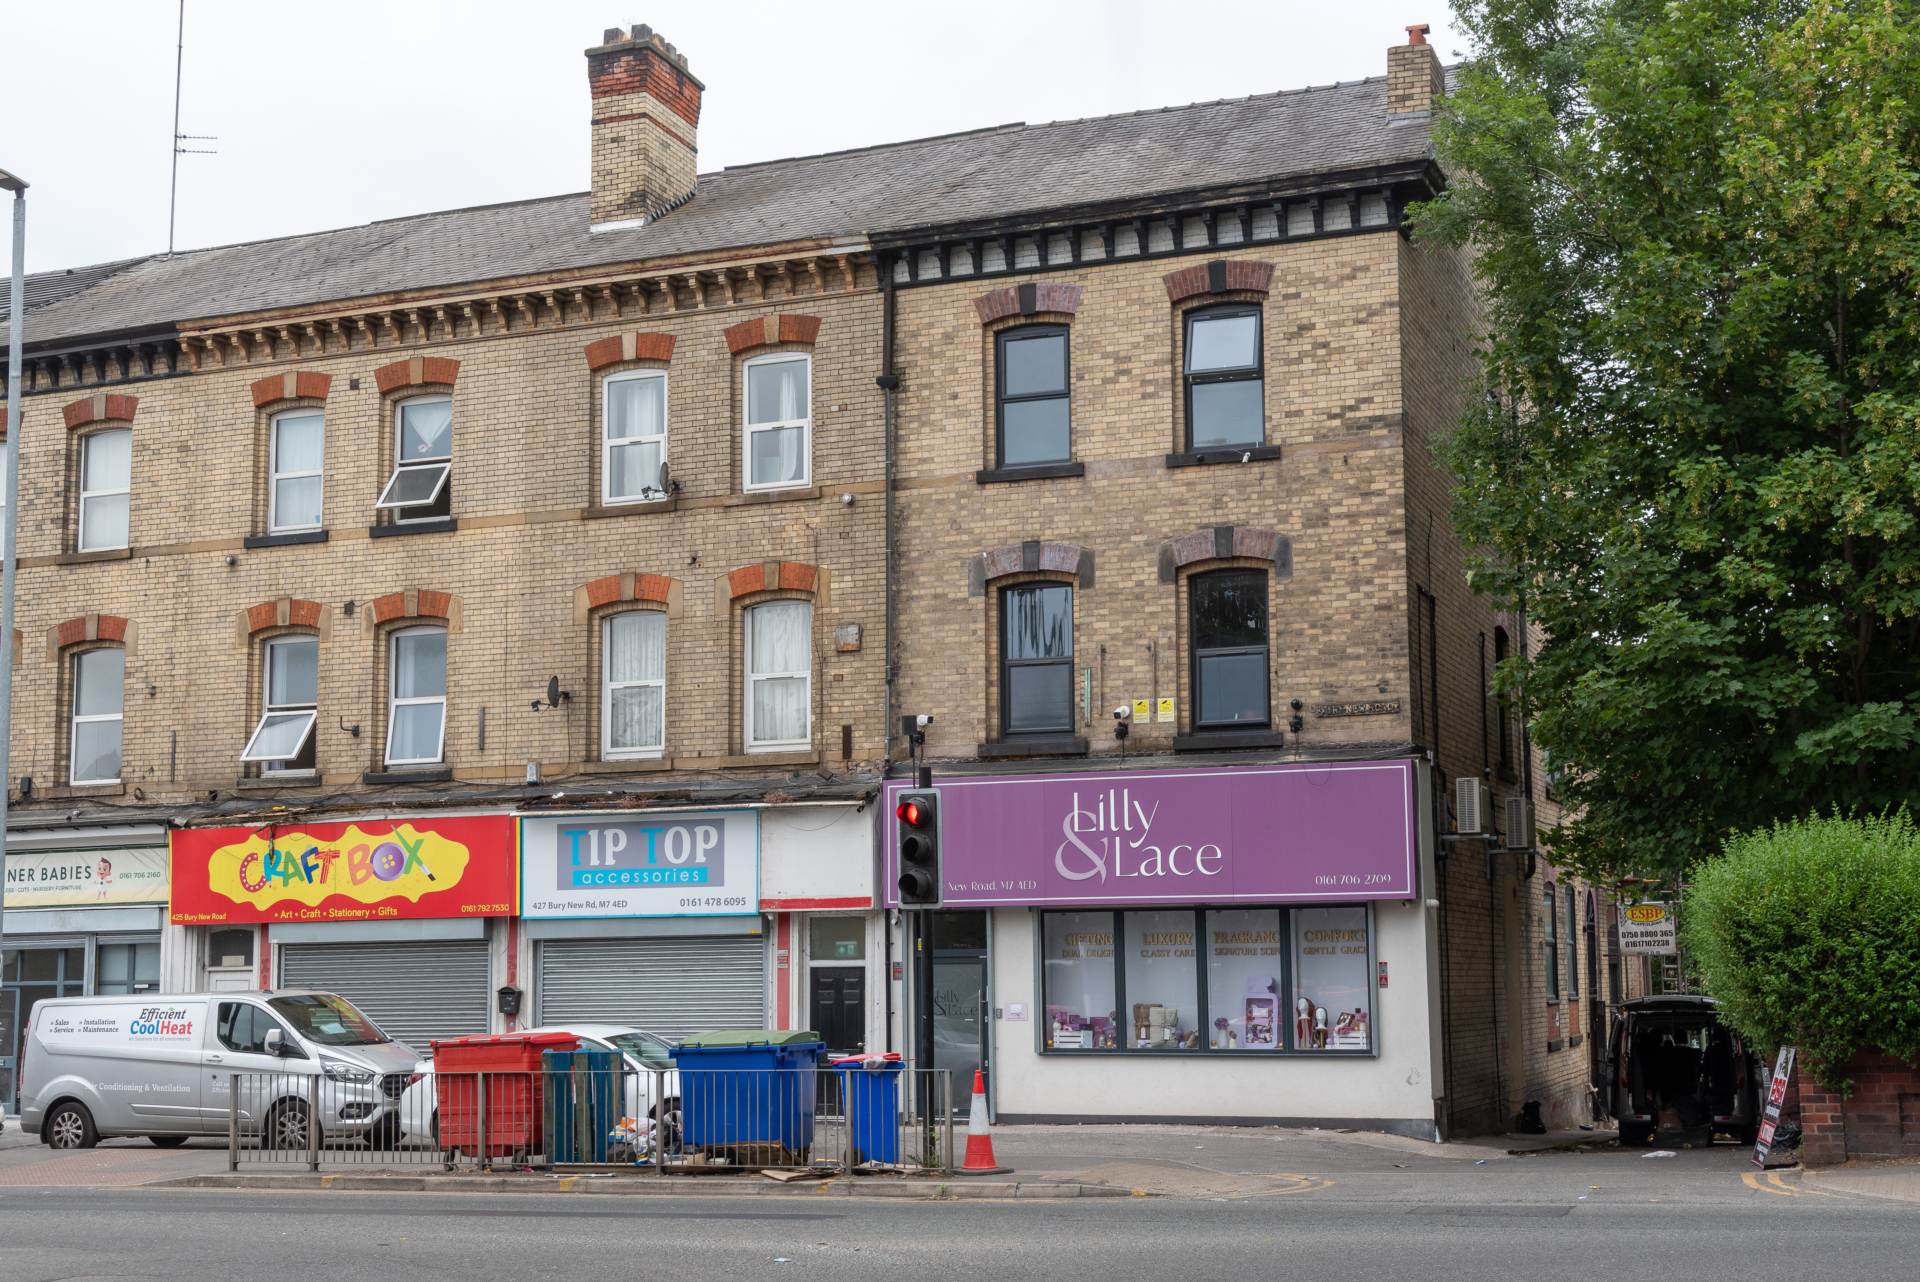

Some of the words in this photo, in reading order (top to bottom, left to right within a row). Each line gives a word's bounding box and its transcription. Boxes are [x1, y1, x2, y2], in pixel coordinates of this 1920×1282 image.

[1073, 788, 1159, 848] Lilly
[562, 828, 628, 866] TIP
[639, 826, 719, 864] TOP
[1054, 810, 1109, 887] &
[1115, 836, 1223, 877] Lace
[240, 847, 340, 892] CRAFT
[347, 825, 435, 886] BOX
[7, 868, 36, 883] NER
[40, 865, 92, 881] BABIES
[119, 872, 132, 880] 0161
[581, 868, 700, 885] accessories
[1315, 875, 1336, 885] 0161
[1341, 874, 1361, 885] 706
[1364, 874, 1391, 885] 2709
[461, 904, 477, 912] 0161
[532, 902, 546, 910] 427
[548, 901, 566, 911] Bury
[567, 901, 584, 909] New
[598, 900, 611, 908] M7
[612, 900, 628, 908] 4ED
[679, 898, 701, 907] 0161
[704, 897, 722, 907] 478
[723, 897, 746, 906] 6095
[172, 913, 184, 921] 425
[184, 913, 197, 922] Bury
[211, 912, 227, 920] Road
[280, 909, 293, 919] Art
[300, 908, 321, 918] Craft
[328, 907, 370, 919] Stationery
[378, 906, 398, 916] Gifts
[1631, 908, 1662, 919] ESBP
[1142, 932, 1193, 945] LUXURY
[1304, 929, 1365, 943] COMFORT
[139, 1007, 187, 1023] Efficient
[83, 1018, 116, 1026] Installation
[130, 1020, 193, 1035] CoolHeat
[99, 1082, 143, 1093] Conditioning
[145, 1083, 150, 1091] &
[152, 1083, 191, 1092] Ventilation
